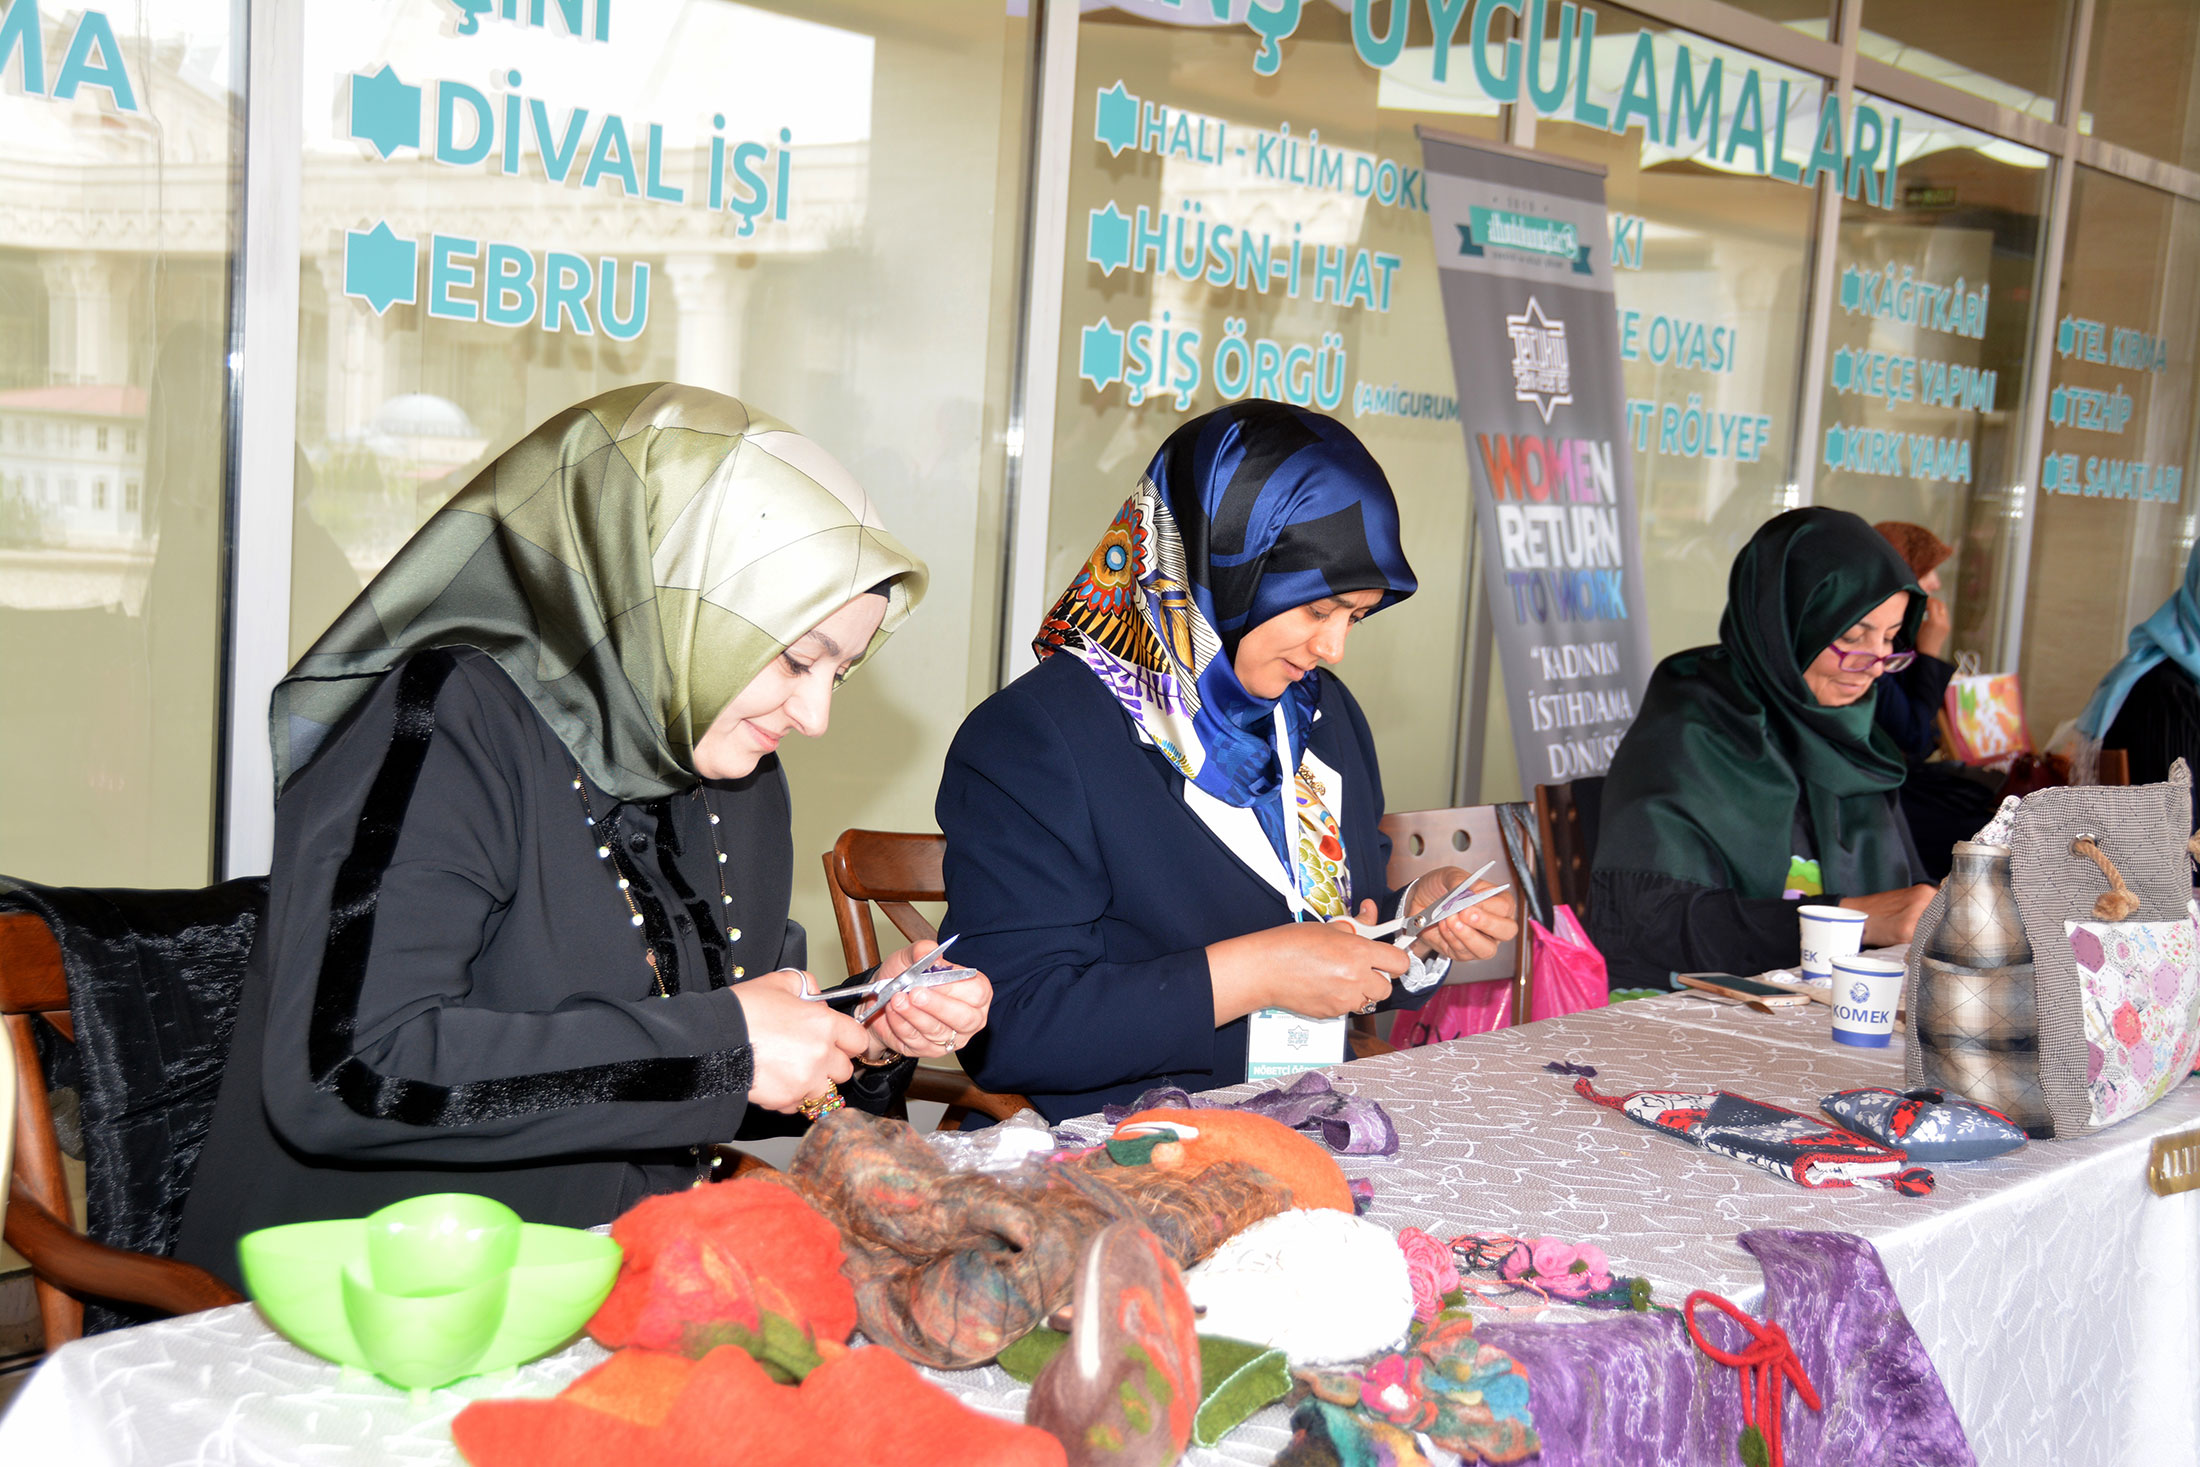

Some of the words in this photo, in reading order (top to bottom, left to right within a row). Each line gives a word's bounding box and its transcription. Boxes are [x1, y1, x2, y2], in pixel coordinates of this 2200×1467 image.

[435, 70, 684, 204] DİVAL
[708, 113, 792, 237] İŞİ
[1141, 101, 1225, 166] HALI
[1256, 121, 1344, 192] KİLİM
[428, 232, 651, 341] EBRU
[1314, 244, 1401, 312] HAT
[1125, 311, 1199, 411] ŞİŞ
[1213, 317, 1346, 410] ÖRGÜ
[1648, 316, 1736, 372] OYASI
[2074, 318, 2108, 365] TEL
[2110, 325, 2167, 374] KIRMA
[1852, 348, 1917, 411] KEÇE
[1920, 359, 1997, 413] YAPIMI
[2067, 384, 2133, 434] TEZHİP
[1660, 393, 1772, 462] RÖLYEF
[1844, 426, 1906, 477] KIRK
[1908, 435, 1972, 483] YAMA
[1477, 433, 1617, 504] WOMEN
[2057, 453, 2081, 495] EL
[2083, 456, 2182, 504] SANATLARI
[1496, 504, 1623, 568] RETURN
[1505, 573, 1548, 625] TO
[1549, 569, 1627, 622] WORK
[1528, 687, 1633, 731] İSTİHDAMA
[1801, 949, 1818, 964] EK
[1833, 1004, 1890, 1024] KOMEK
